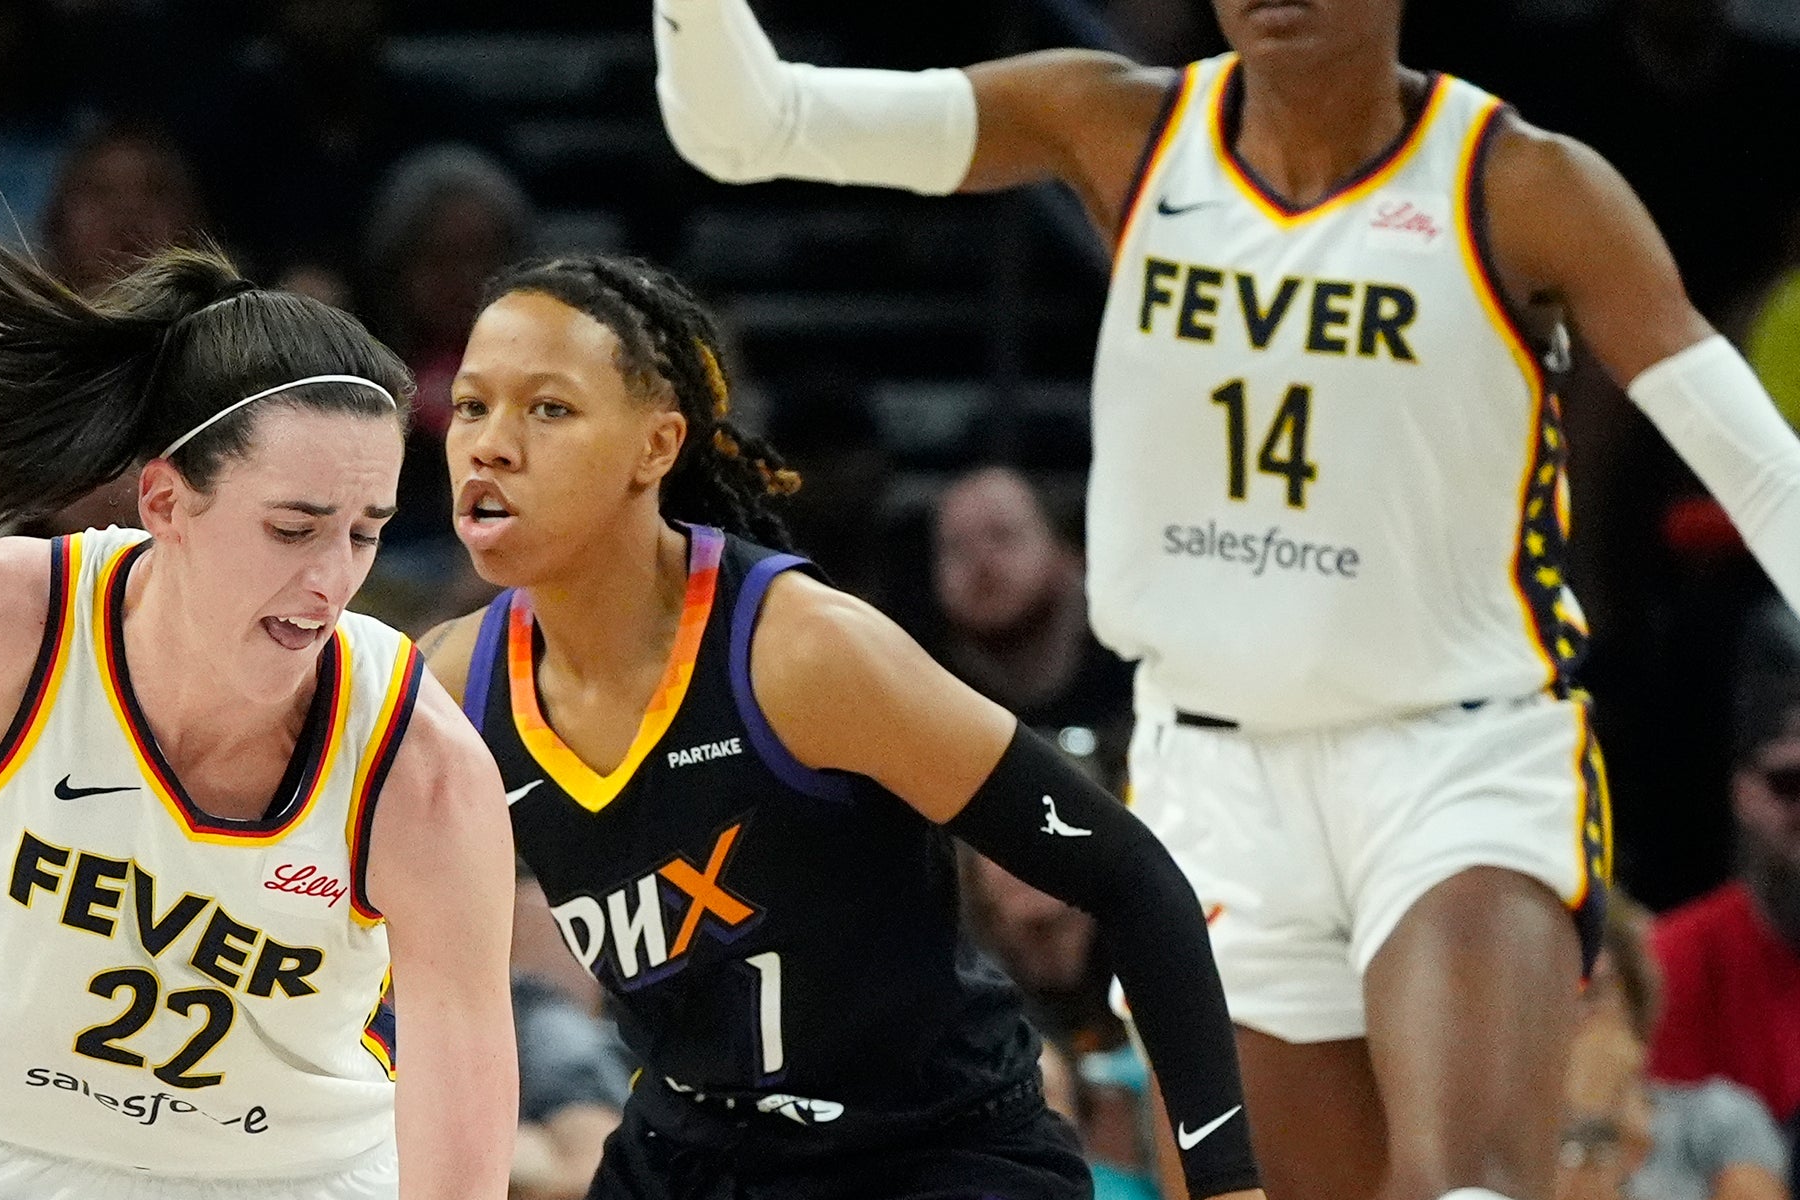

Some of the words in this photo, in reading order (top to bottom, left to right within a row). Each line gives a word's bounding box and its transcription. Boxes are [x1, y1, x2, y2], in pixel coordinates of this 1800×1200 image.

[1138, 256, 1419, 364] FEVER
[1211, 378, 1317, 509] 14
[1163, 521, 1360, 577] salesforce
[667, 737, 743, 769] PARTAKE
[8, 829, 325, 1000] FEVER
[264, 864, 348, 907] Lilly
[73, 966, 238, 1090] 22
[745, 951, 784, 1074] 1
